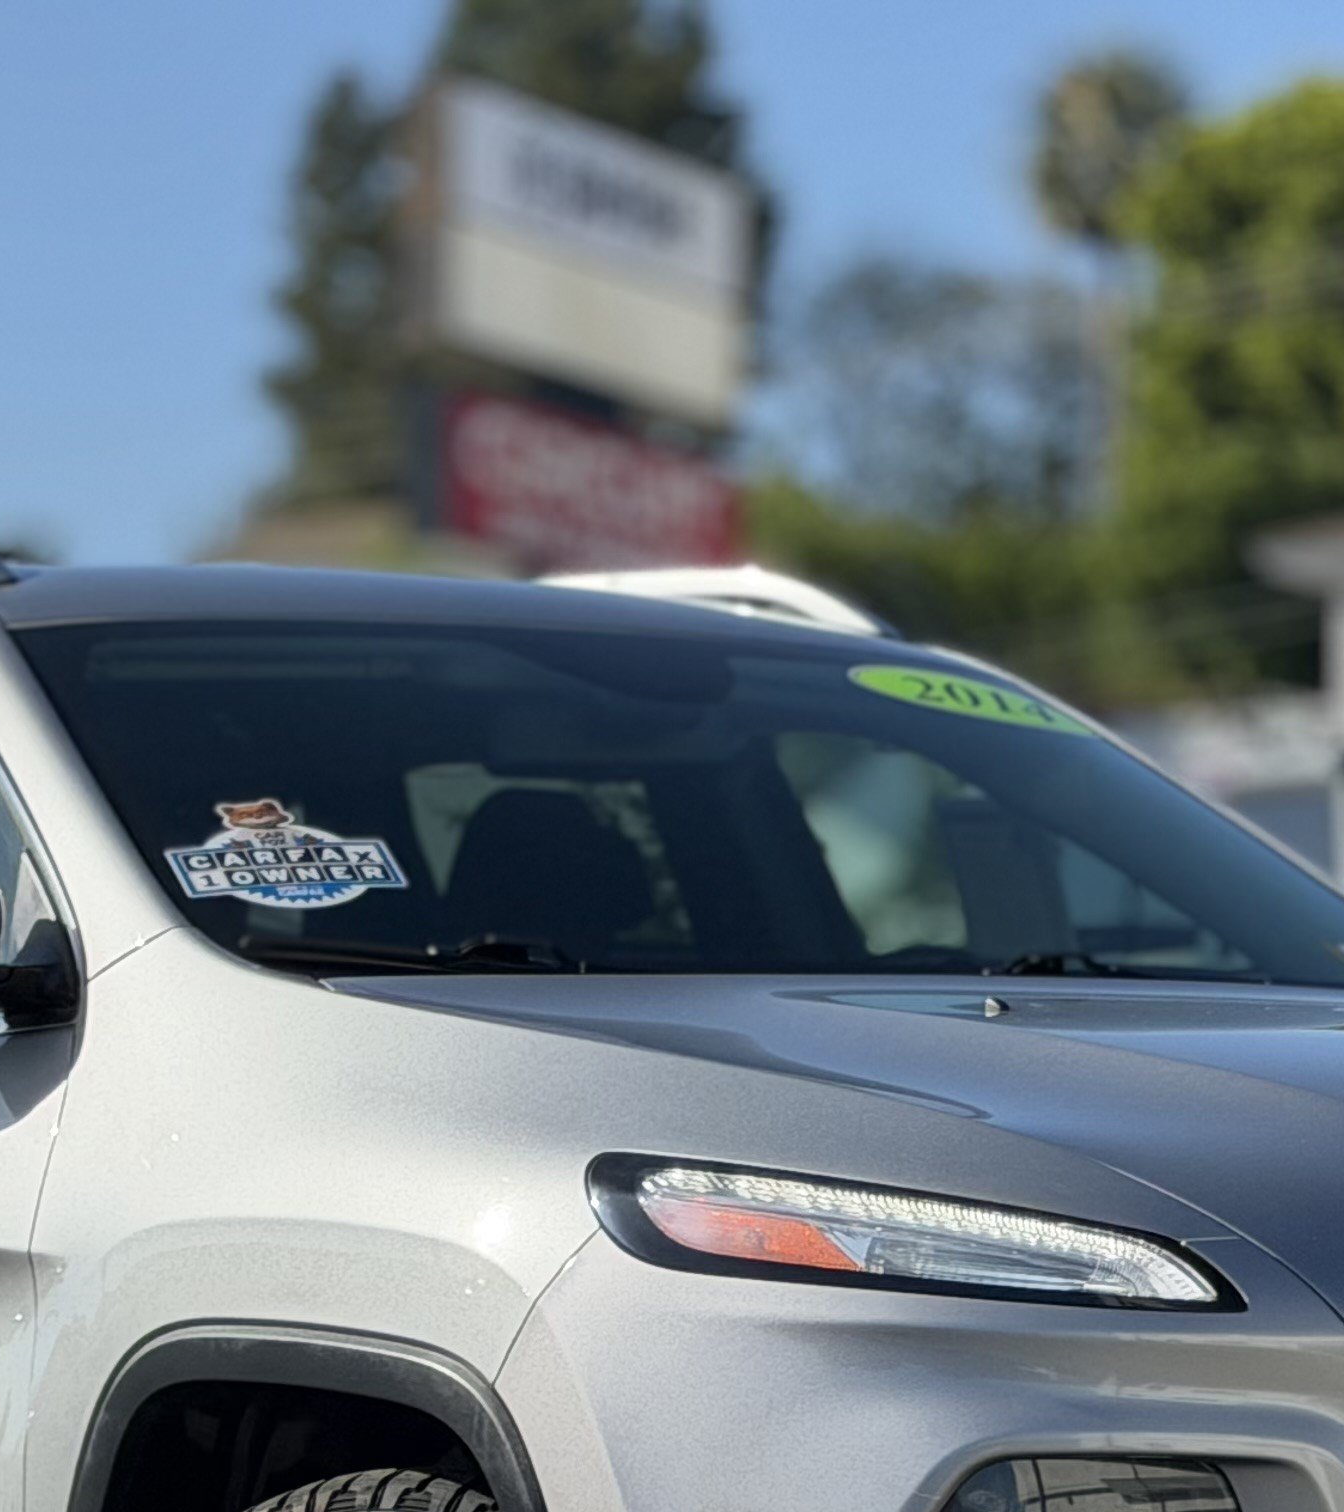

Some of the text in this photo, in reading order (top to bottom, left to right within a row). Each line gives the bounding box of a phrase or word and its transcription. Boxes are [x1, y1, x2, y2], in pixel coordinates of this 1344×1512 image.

[188, 848, 382, 869] CARFAX
[202, 866, 386, 888] 1 OWNER
